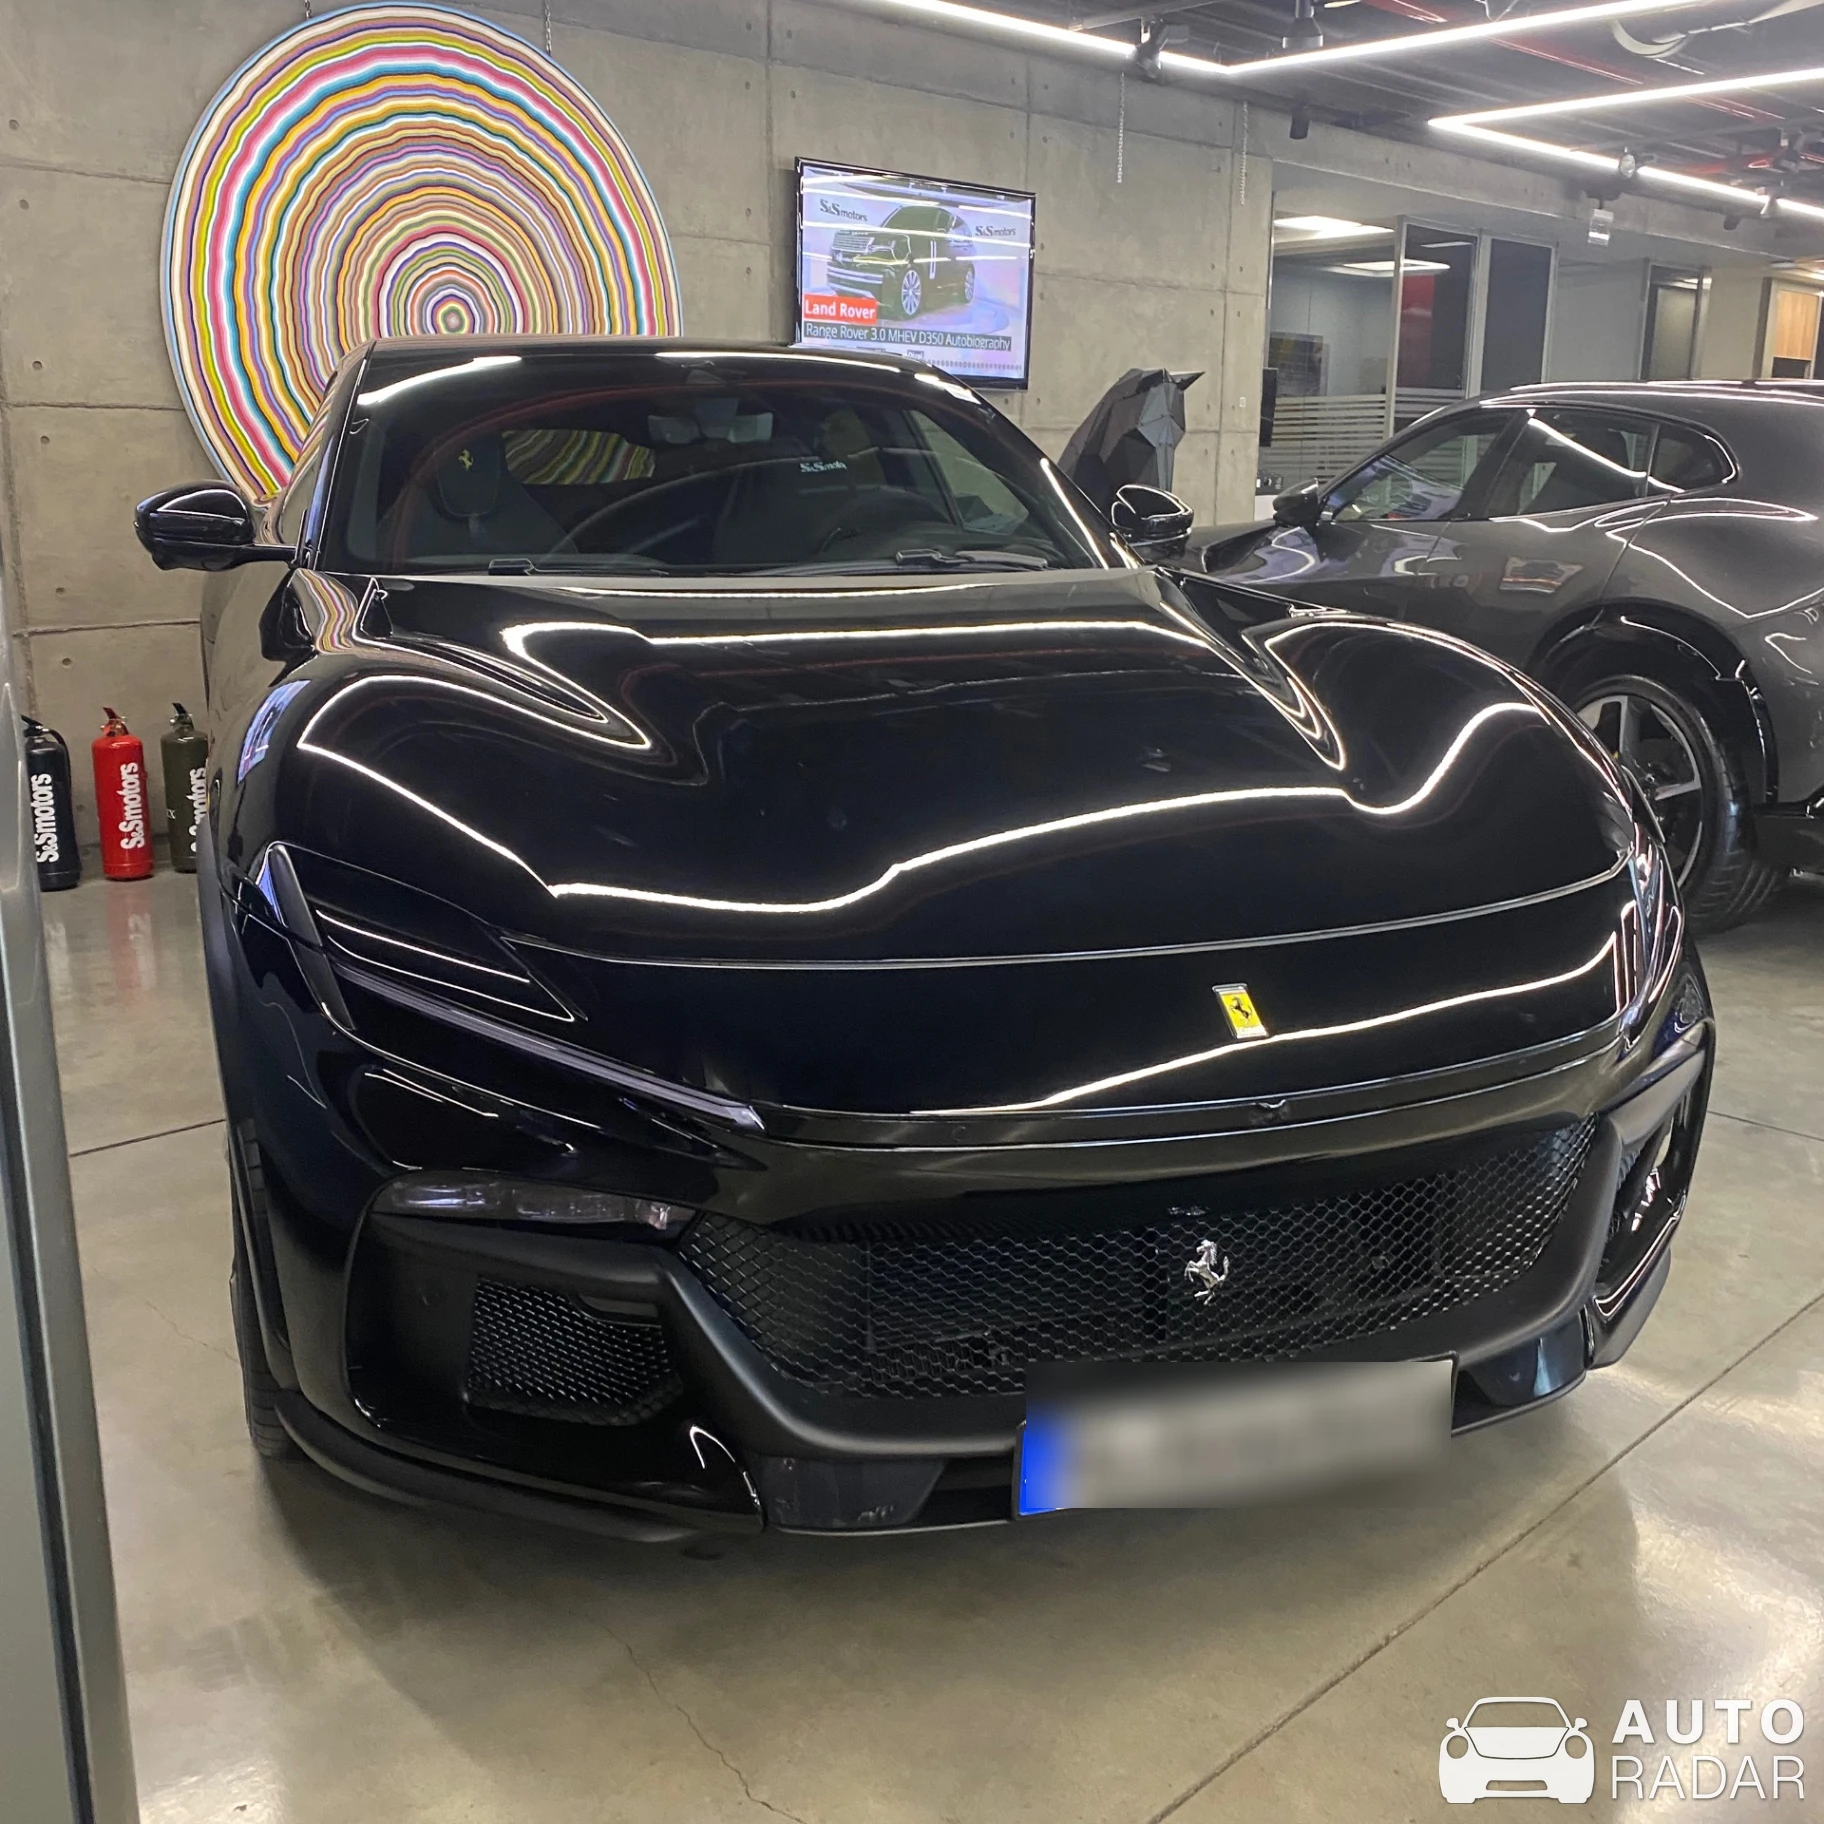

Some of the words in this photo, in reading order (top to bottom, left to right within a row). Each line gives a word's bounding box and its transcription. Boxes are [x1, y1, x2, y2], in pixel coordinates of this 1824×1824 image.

[805, 300, 836, 316] Land
[840, 303, 876, 319] Rover
[806, 323, 838, 339] Range
[840, 325, 868, 340] Rover
[870, 327, 886, 341] 3.0
[888, 329, 917, 343] MHEV
[919, 331, 944, 345] D350
[945, 333, 1011, 350] Autobiography
